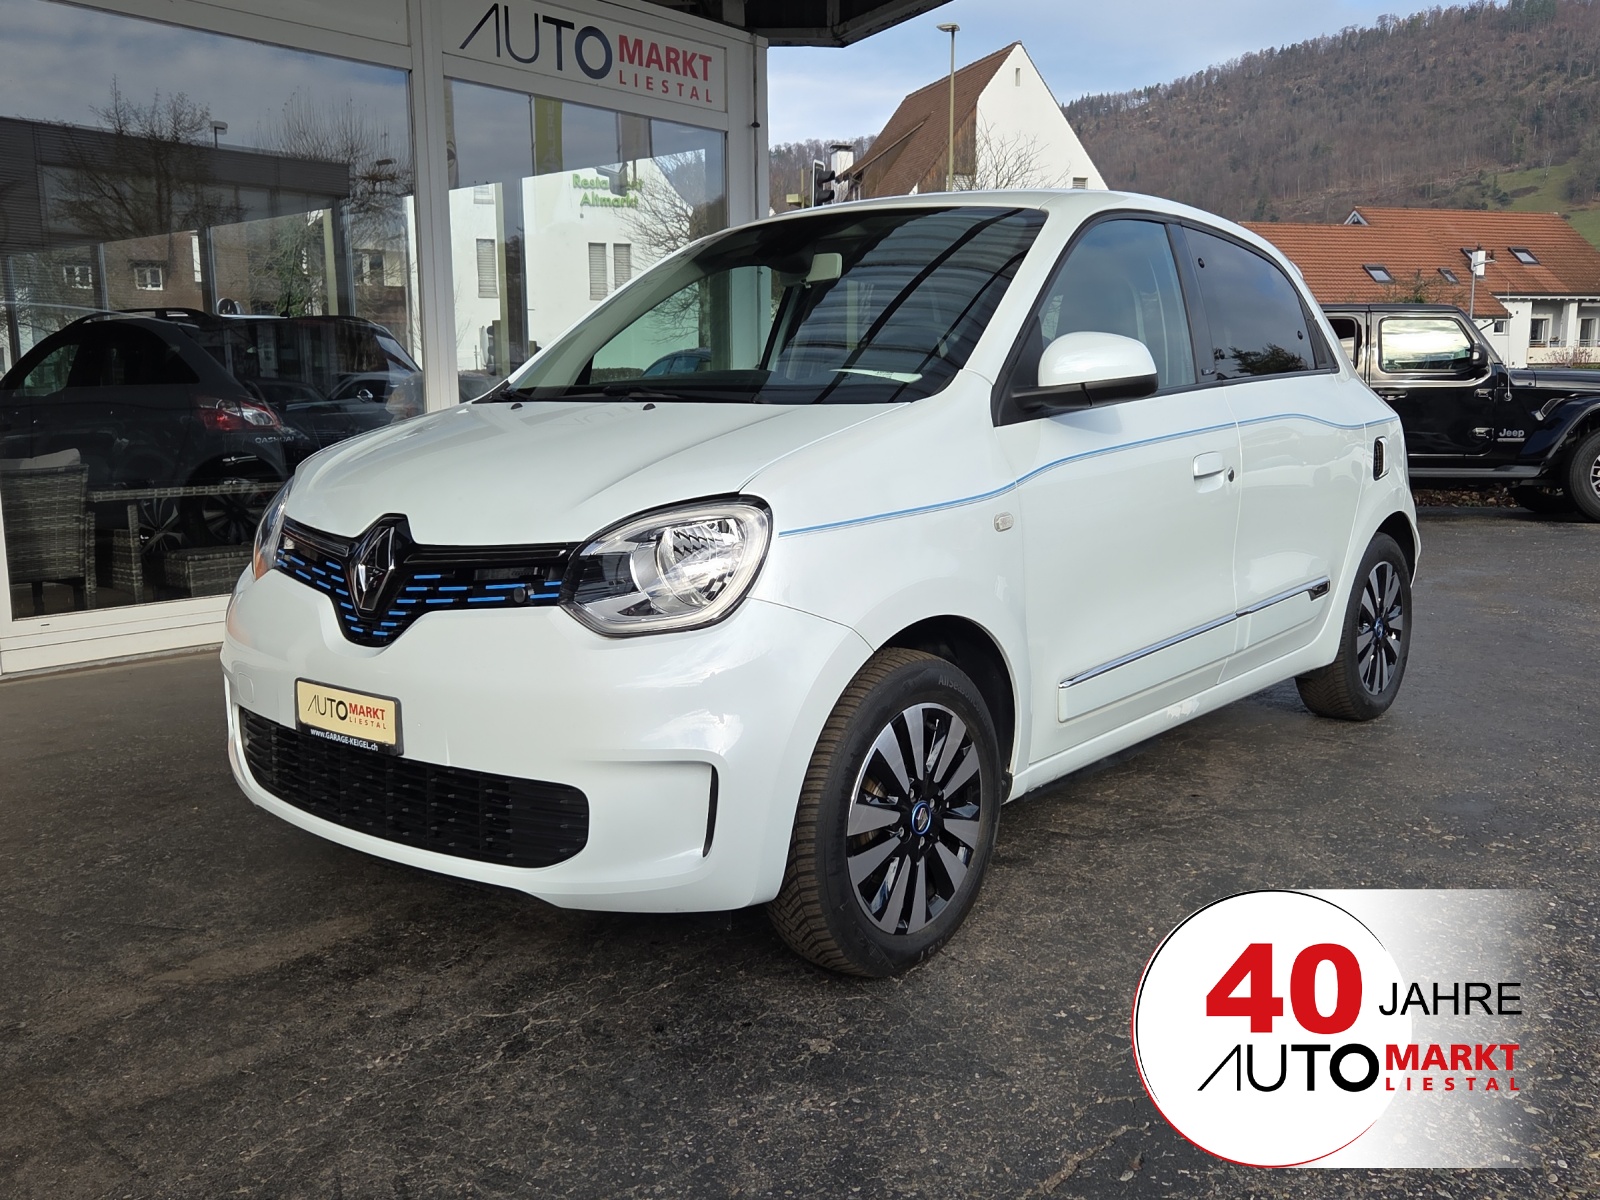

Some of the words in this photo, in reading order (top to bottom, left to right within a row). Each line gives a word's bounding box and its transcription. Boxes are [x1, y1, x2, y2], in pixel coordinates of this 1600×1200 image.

[619, 69, 712, 103] LIESTAL
[580, 191, 639, 208] Altmarkt
[1499, 428, 1525, 438] Jeep
[349, 716, 387, 730] LIESTAL
[310, 728, 378, 752] www.GARAGE-KEIGEL.ch
